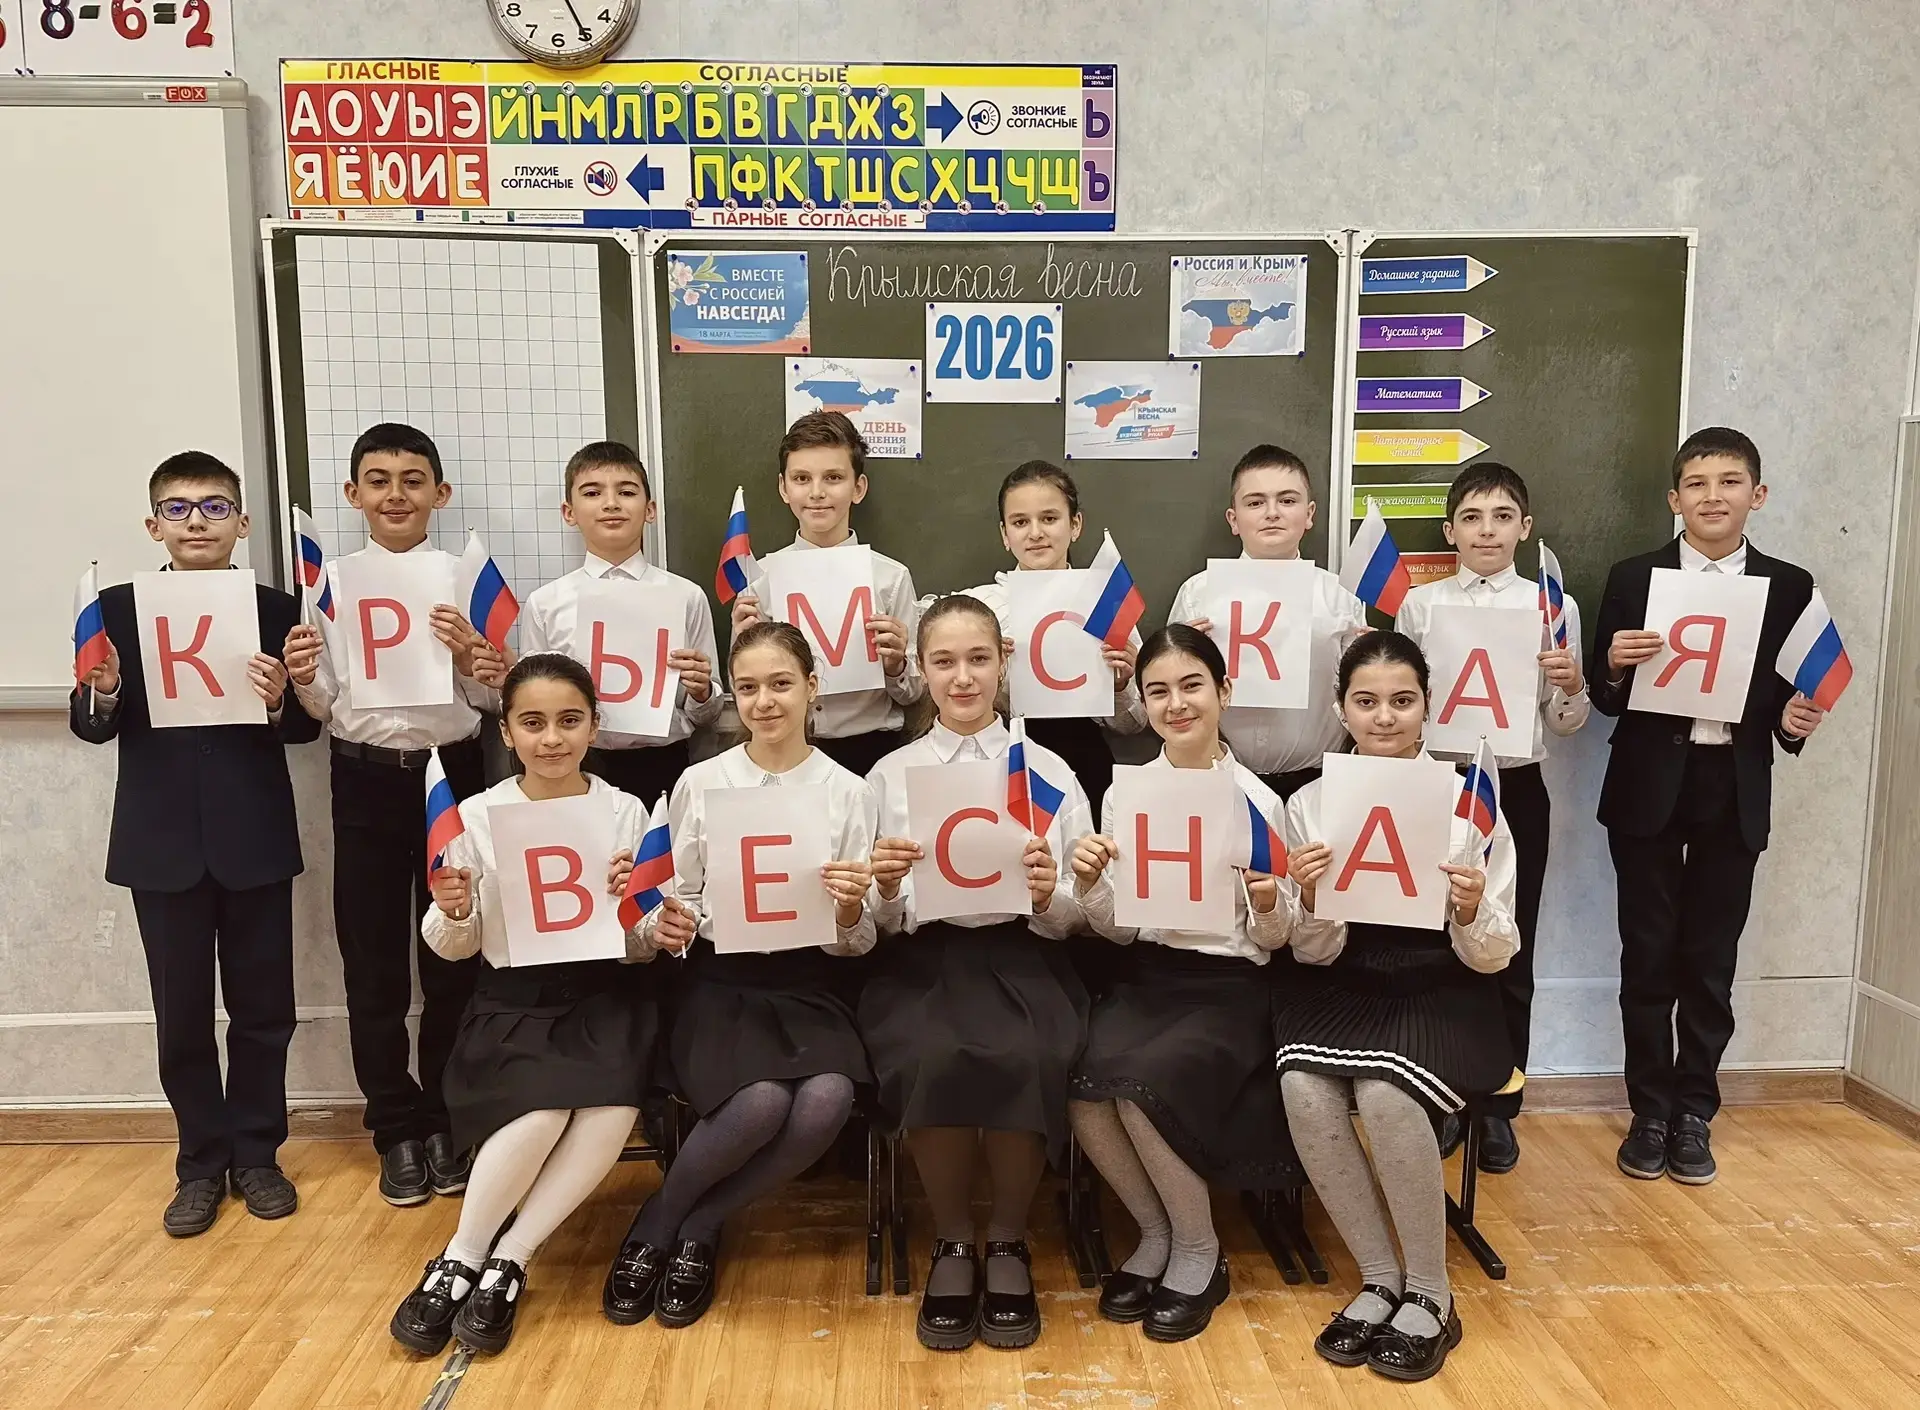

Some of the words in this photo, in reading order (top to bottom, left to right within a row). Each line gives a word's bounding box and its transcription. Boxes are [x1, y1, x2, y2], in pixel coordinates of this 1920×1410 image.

[506, 3, 522, 17] 8
[597, 9, 611, 23] 4
[526, 24, 538, 38] 7
[578, 27, 592, 42] 5
[551, 33, 565, 48] 6
[327, 62, 440, 81] ГЛАСНЫЕ
[699, 65, 848, 83] СОГЛАСНЫЕ
[168, 88, 205, 99] FOX
[1012, 105, 1066, 116] ЗВОНКИЕ
[1085, 98, 1111, 138] Ь
[1007, 118, 1077, 129] СОГЛАСНЫЕ
[514, 166, 559, 176] ГЛУХИЕ
[501, 178, 574, 189] СОГЛАСНЫЕ
[1084, 160, 1110, 201] Ъ
[712, 212, 788, 226] ПАРНЫЕ
[799, 213, 907, 227] СОГЛАСНЫЕ
[1184, 257, 1234, 271] Россия
[1239, 259, 1248, 270] и
[1253, 256, 1296, 273] Крым
[732, 269, 785, 282] ВМЕСТЕ
[826, 246, 1024, 307] Крымская
[1369, 269, 1419, 281] Домашнее
[1420, 269, 1460, 283] задание
[709, 288, 718, 300] С
[722, 286, 785, 300] РОССИЕЙ
[697, 305, 786, 323] НАВСЕГДА!
[1380, 325, 1418, 341] Русский
[1420, 327, 1443, 340] язык
[935, 314, 1054, 381] 2026
[1375, 387, 1442, 399] Математика
[862, 422, 907, 434] ДЕНЬ
[1428, 497, 1448, 509] мир
[1427, 565, 1449, 577] язык
[786, 586, 879, 668] М
[357, 597, 412, 681] Р
[1227, 600, 1282, 681] К
[155, 614, 225, 699] К
[1028, 610, 1087, 691] С
[1653, 614, 1727, 694] Я
[590, 620, 669, 708] Ы
[1437, 648, 1509, 729] А
[935, 806, 1002, 888] С
[1334, 805, 1419, 897] А
[1135, 812, 1203, 903] Н
[740, 834, 798, 923] Е
[524, 845, 594, 933] В
